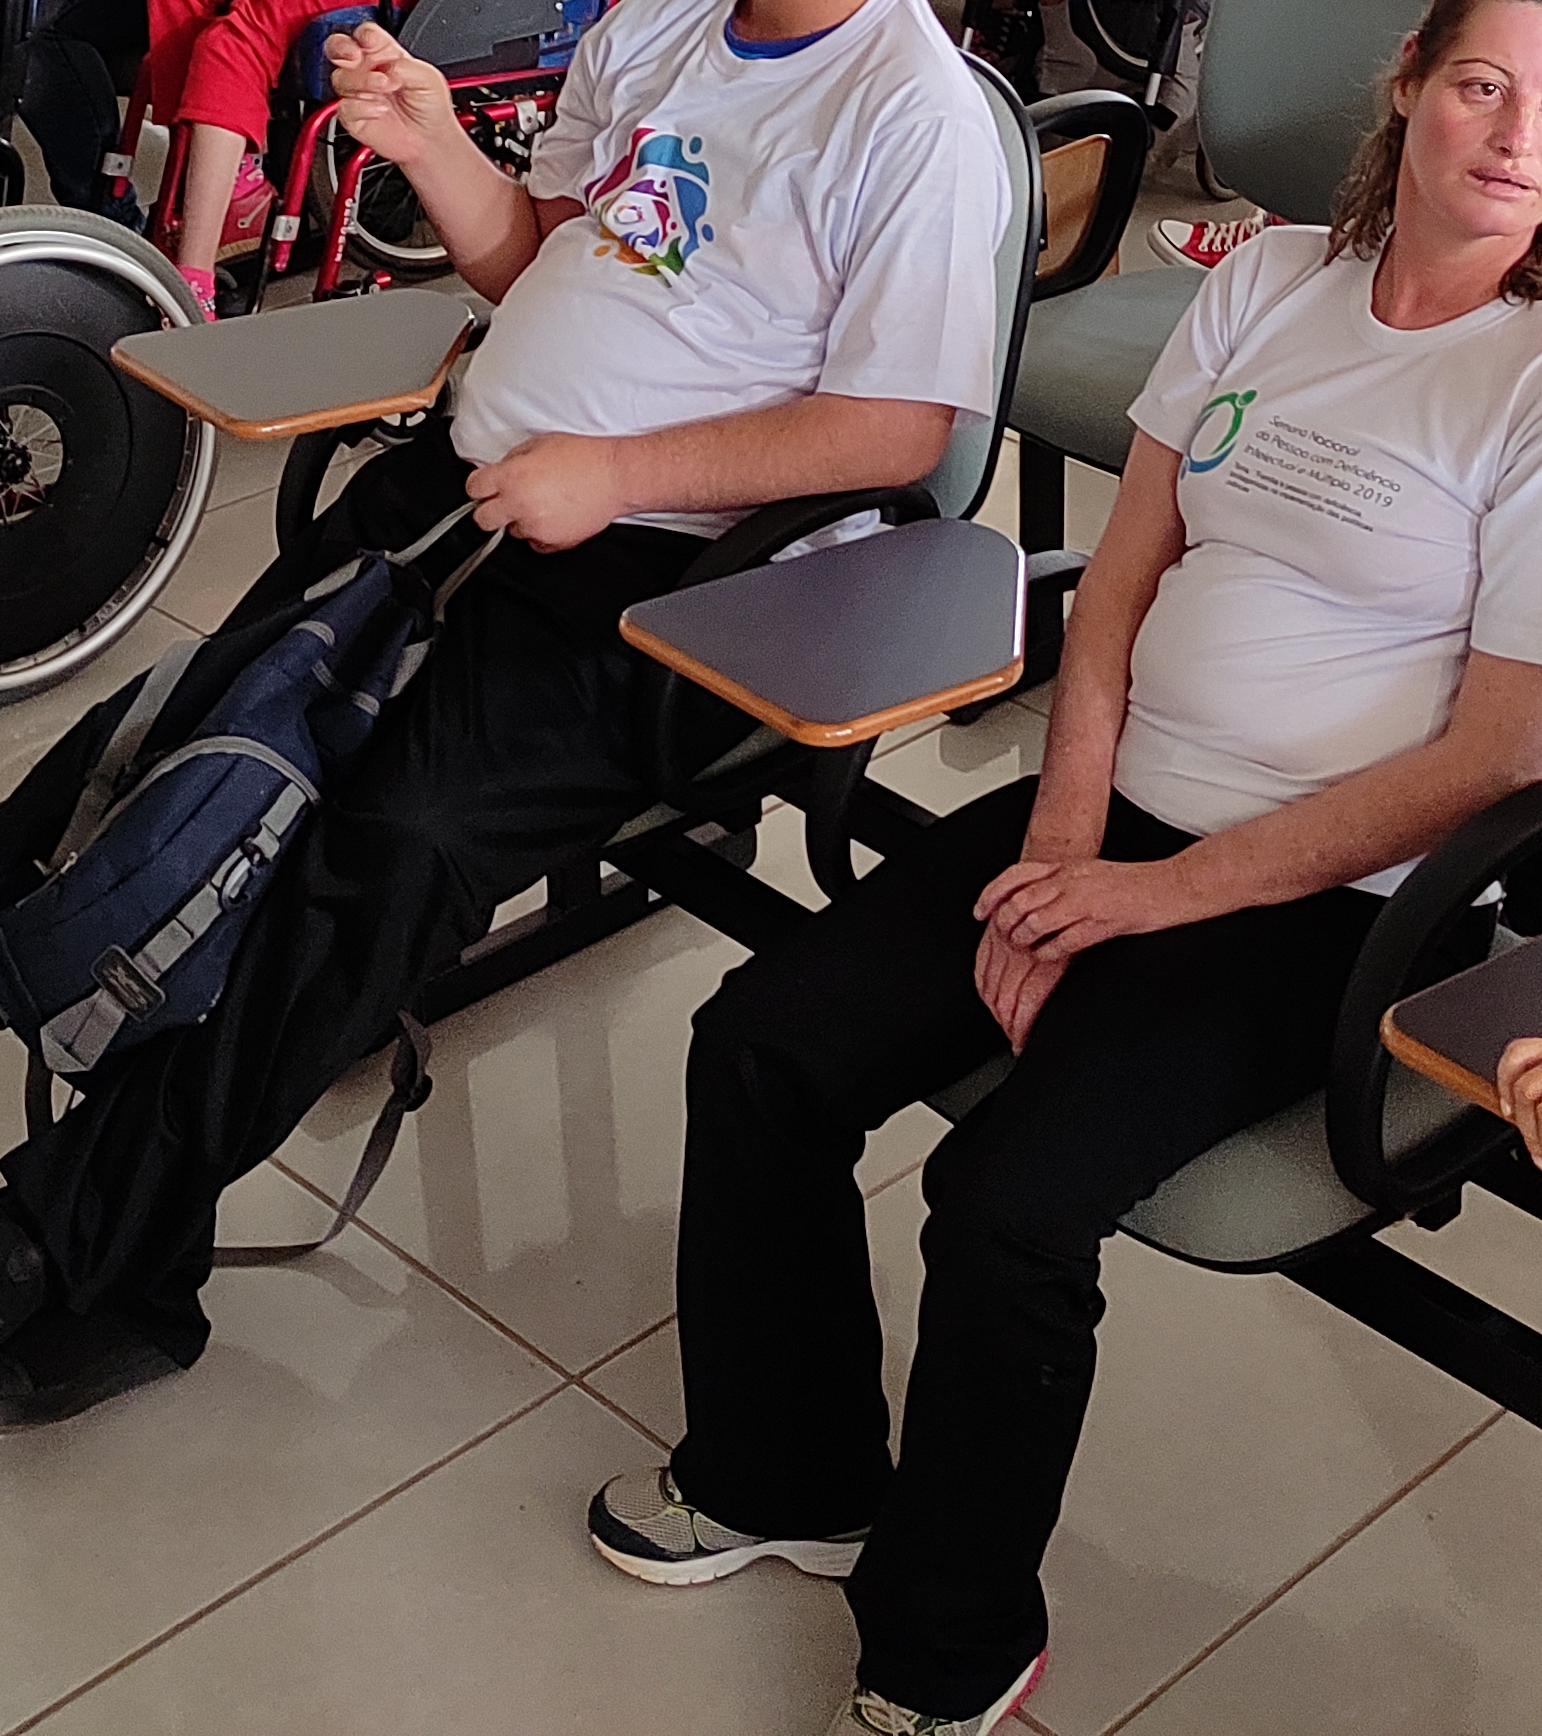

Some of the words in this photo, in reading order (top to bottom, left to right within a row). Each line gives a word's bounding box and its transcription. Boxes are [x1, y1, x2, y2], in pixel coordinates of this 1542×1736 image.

[1270, 433, 1309, 459] Pessoa
[1310, 430, 1361, 456] Nacional
[1352, 482, 1394, 508] 2019
